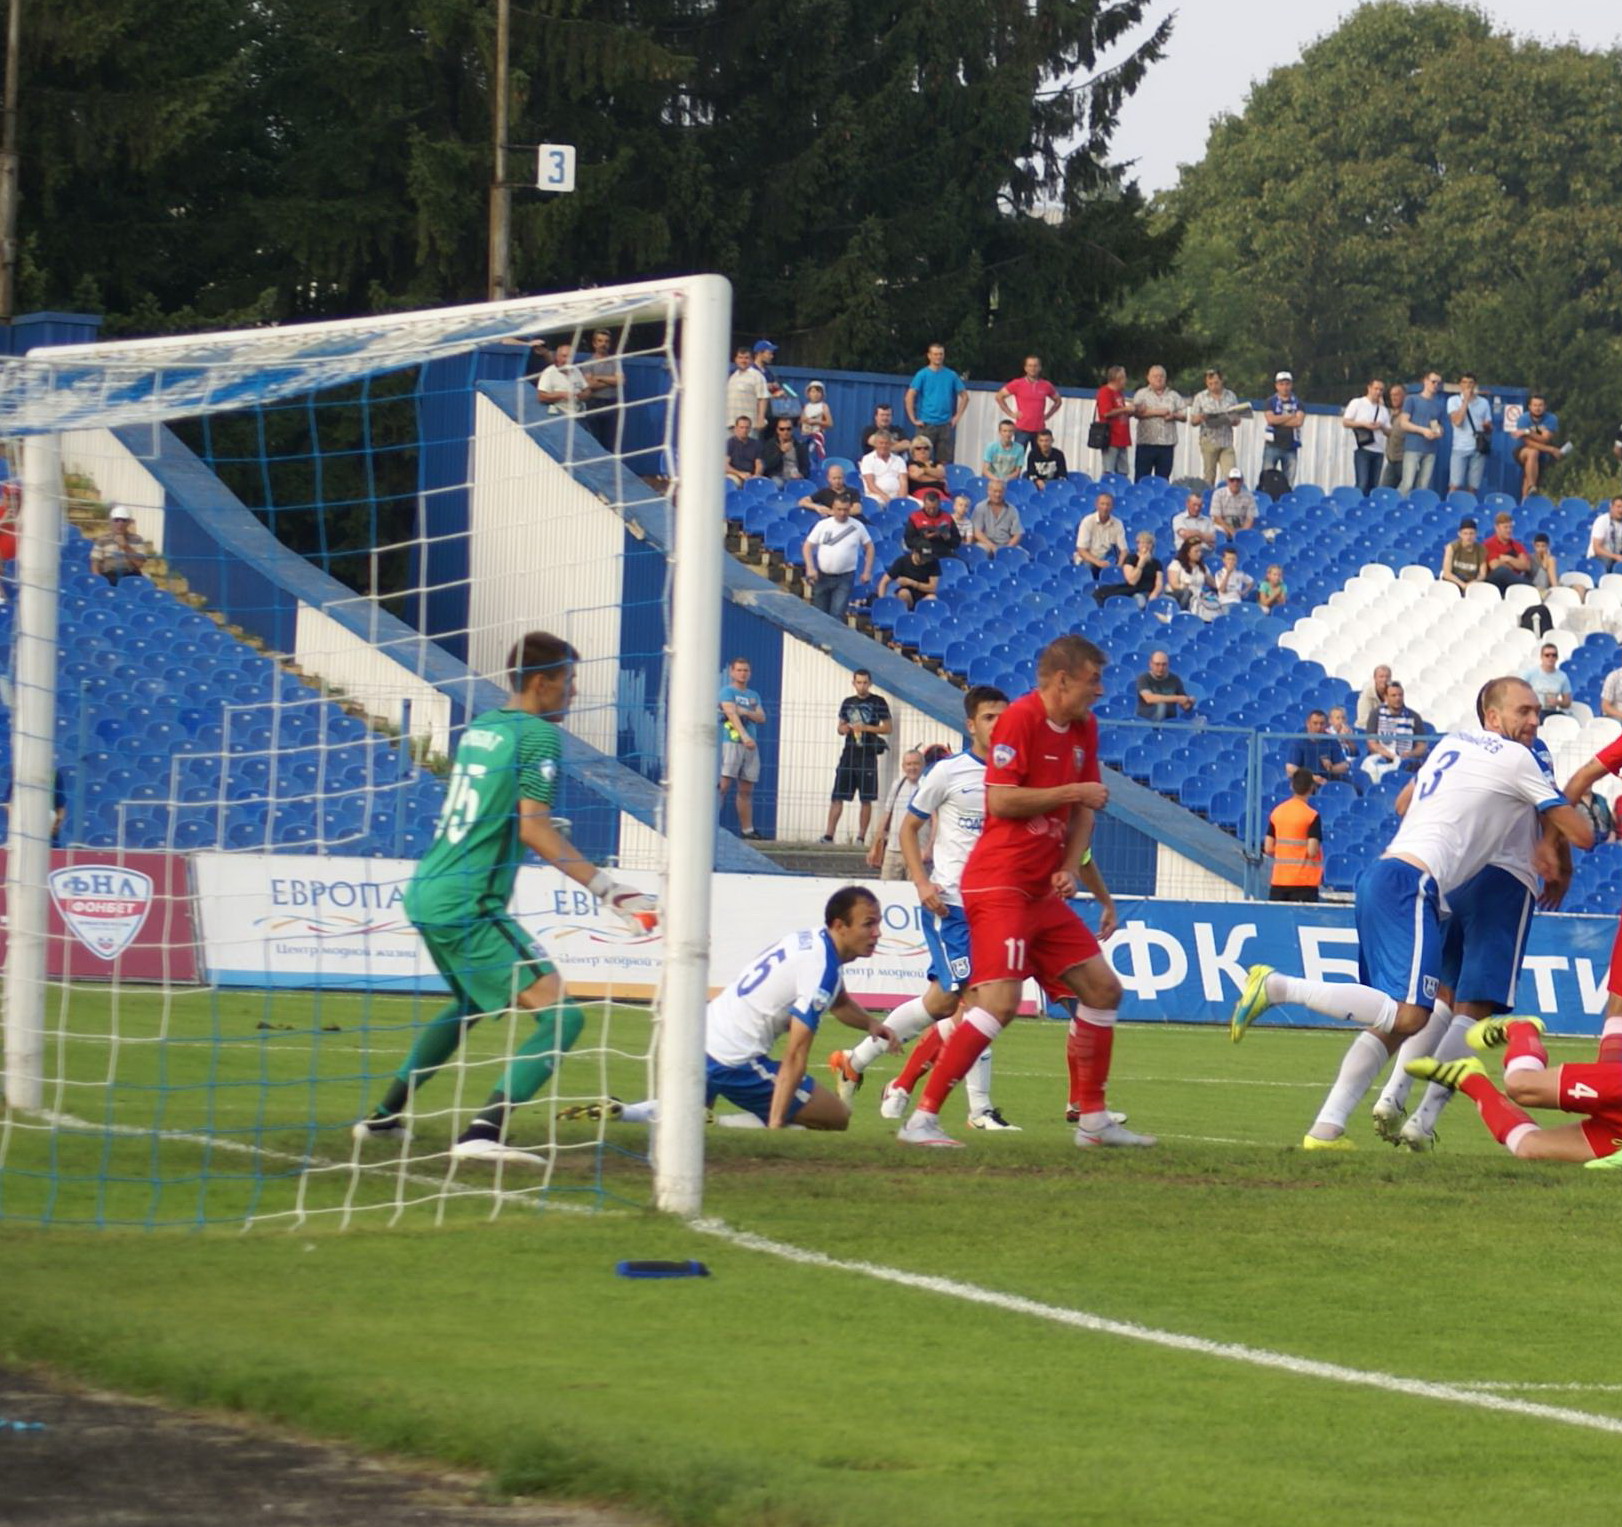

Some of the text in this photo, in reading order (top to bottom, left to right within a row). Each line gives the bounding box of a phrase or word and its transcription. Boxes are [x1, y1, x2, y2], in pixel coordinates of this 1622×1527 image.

[548, 151, 565, 184] 3
[1419, 750, 1461, 800] 3
[72, 901, 135, 914] ФОНБЕТ
[271, 878, 404, 909] ЕВРОПА
[1004, 936, 1025, 971] 11
[1096, 920, 1260, 1002] ФК
[1567, 1081, 1599, 1100] 4
